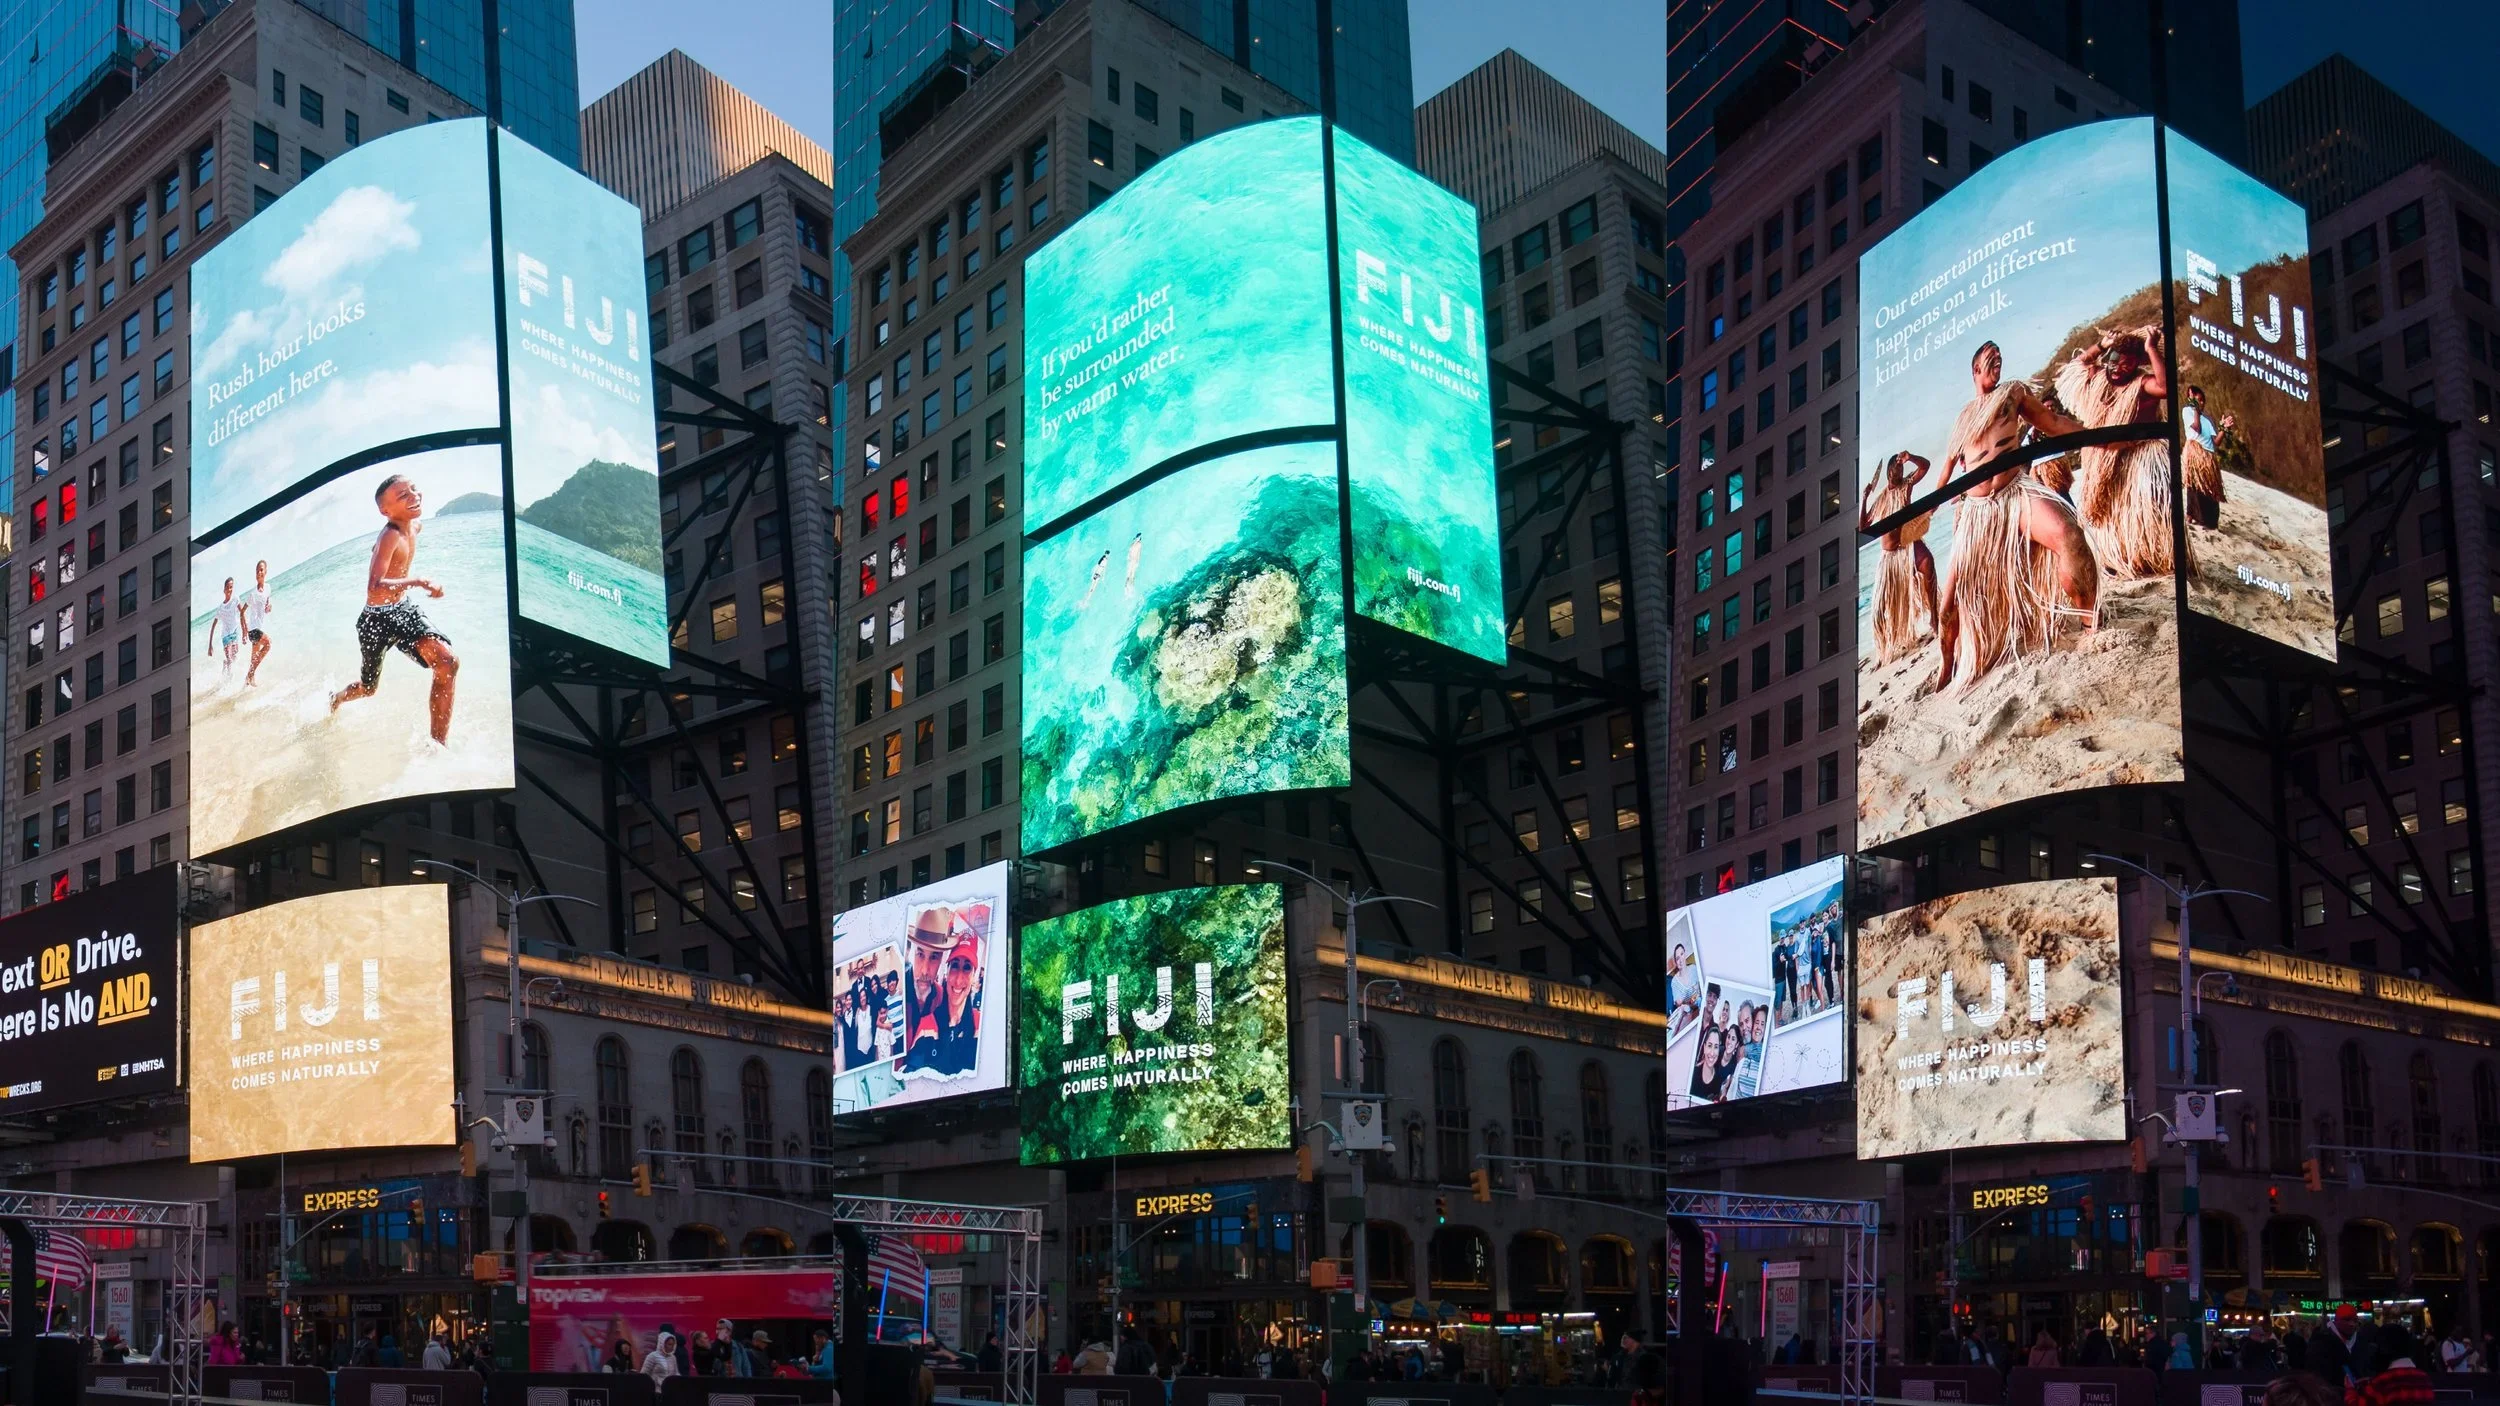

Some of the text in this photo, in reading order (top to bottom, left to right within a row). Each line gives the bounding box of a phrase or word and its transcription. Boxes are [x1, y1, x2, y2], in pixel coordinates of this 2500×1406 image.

[1874, 219, 2035, 330] Our entertainment
[518, 252, 639, 362] FIJI
[1356, 249, 1478, 360] FIJI
[1875, 236, 2076, 359] happens on a different
[2186, 249, 2306, 360] FIJI
[208, 300, 366, 409] Rush hour looks
[520, 318, 641, 388] WHERE HAPPINESS
[1041, 284, 1172, 382] If you'd rather
[1359, 316, 1480, 384] WHERE HAPPINESS
[1874, 296, 2013, 388] kind of sidewalk.
[2190, 315, 2309, 384] WHERE HAPPINESS
[521, 338, 641, 405] COMES NATURALLY
[1041, 305, 1176, 410] be surrounded
[1359, 336, 1480, 402] COMES NATURALLY
[2190, 335, 2309, 402] COMES NATURALLY
[208, 361, 338, 447] different here.
[1041, 343, 1184, 441] by warm water.
[568, 570, 622, 606] fiji.com.fj
[1407, 567, 1460, 603] fiji.com.fj
[2237, 565, 2291, 601] fiji.com.fj
[0, 930, 142, 994] ext OR Drive.
[2285, 958, 2345, 986] MILLER
[2359, 974, 2427, 1001] BUILDING
[0, 972, 158, 1042] ere Is No AND.
[231, 958, 380, 1040] FIJI
[616, 966, 676, 993] MILLER
[691, 981, 760, 1008] BUILDING
[1062, 962, 1212, 1044] FIJI
[1453, 966, 1514, 994] MILLER
[1528, 981, 1599, 1010] BUILDING
[1898, 958, 2046, 1040] FIJI
[606, 1002, 633, 1019] SHOE
[638, 1007, 665, 1025] SHOP
[668, 1013, 722, 1035] DEDICATED
[140, 1058, 164, 1072] NHTSA
[232, 1038, 380, 1069] WHERE HAPPINESS
[232, 1060, 380, 1090] COMES NATURALLY
[1062, 1043, 1213, 1074] WHERE HAPPINESS
[1898, 1038, 2047, 1070] WHERE HAPPINESS
[1062, 1066, 1213, 1095] COMES NATURALLY
[1898, 1062, 2046, 1090] COMES NATURALLY
[304, 1188, 380, 1212] EXPRESS
[1136, 1192, 1213, 1217] EXPRESS
[1973, 1184, 2048, 1210] EXPRESS
[112, 1288, 128, 1303] 1560
[939, 1292, 956, 1309] 1560
[267, 1389, 289, 1398] TIMES
[412, 1394, 436, 1404] TIMES
[1939, 1389, 1961, 1398] TIMES
[2086, 1393, 2111, 1402] TIMES
